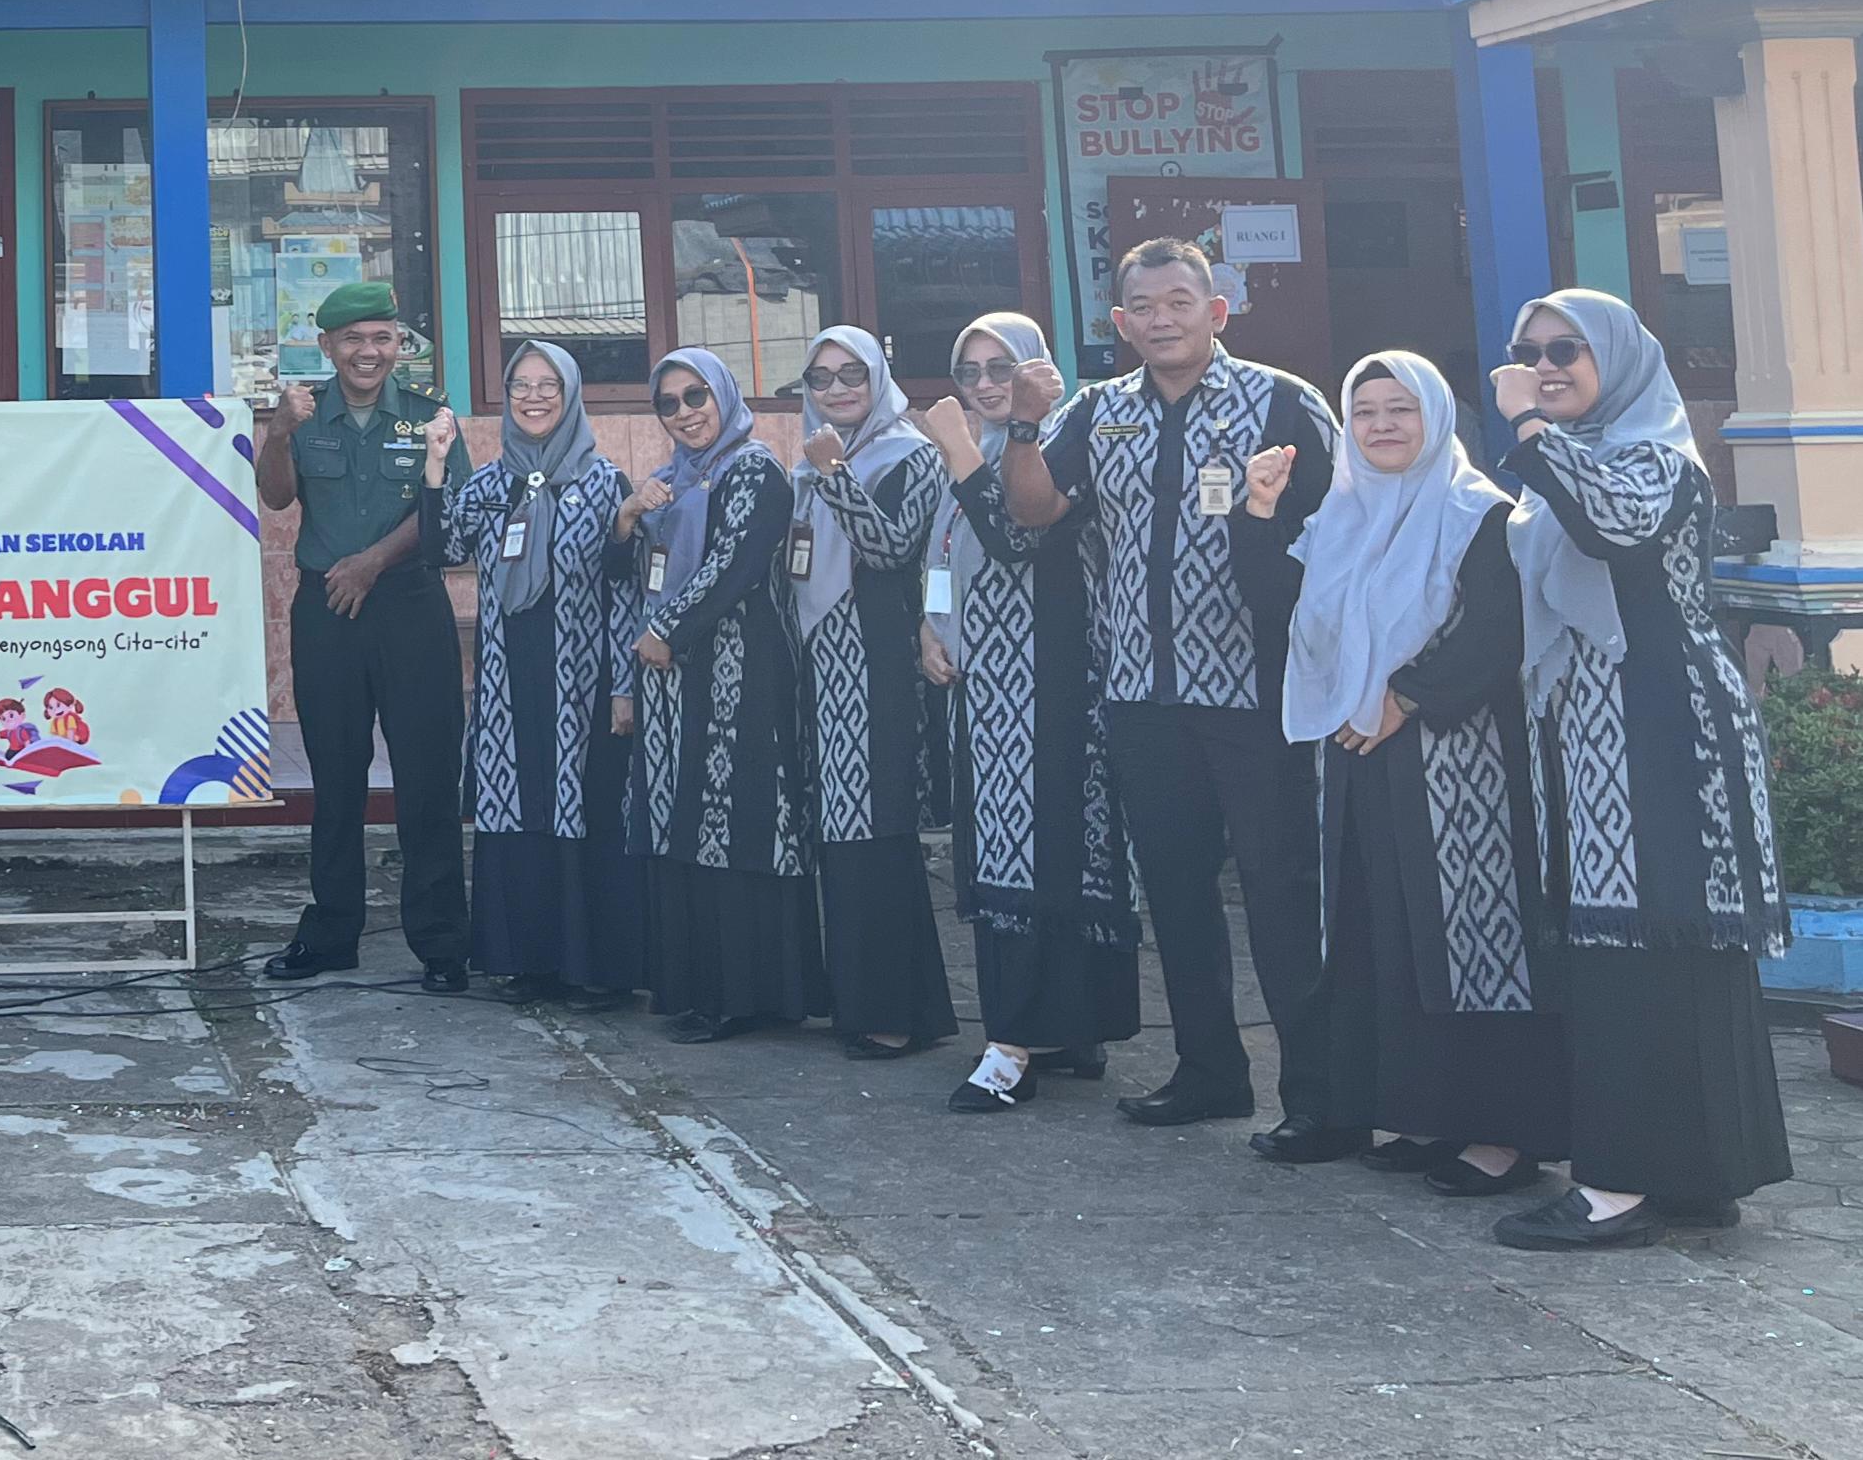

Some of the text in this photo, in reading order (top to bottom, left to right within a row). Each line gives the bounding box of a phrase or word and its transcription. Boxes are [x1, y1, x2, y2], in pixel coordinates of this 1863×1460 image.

[1076, 92, 1181, 122] STOP
[1194, 100, 1235, 123] STOP
[1079, 125, 1260, 157] BULLYING
[1236, 231, 1278, 242] RUANG
[25, 532, 145, 553] SEKOLAH
